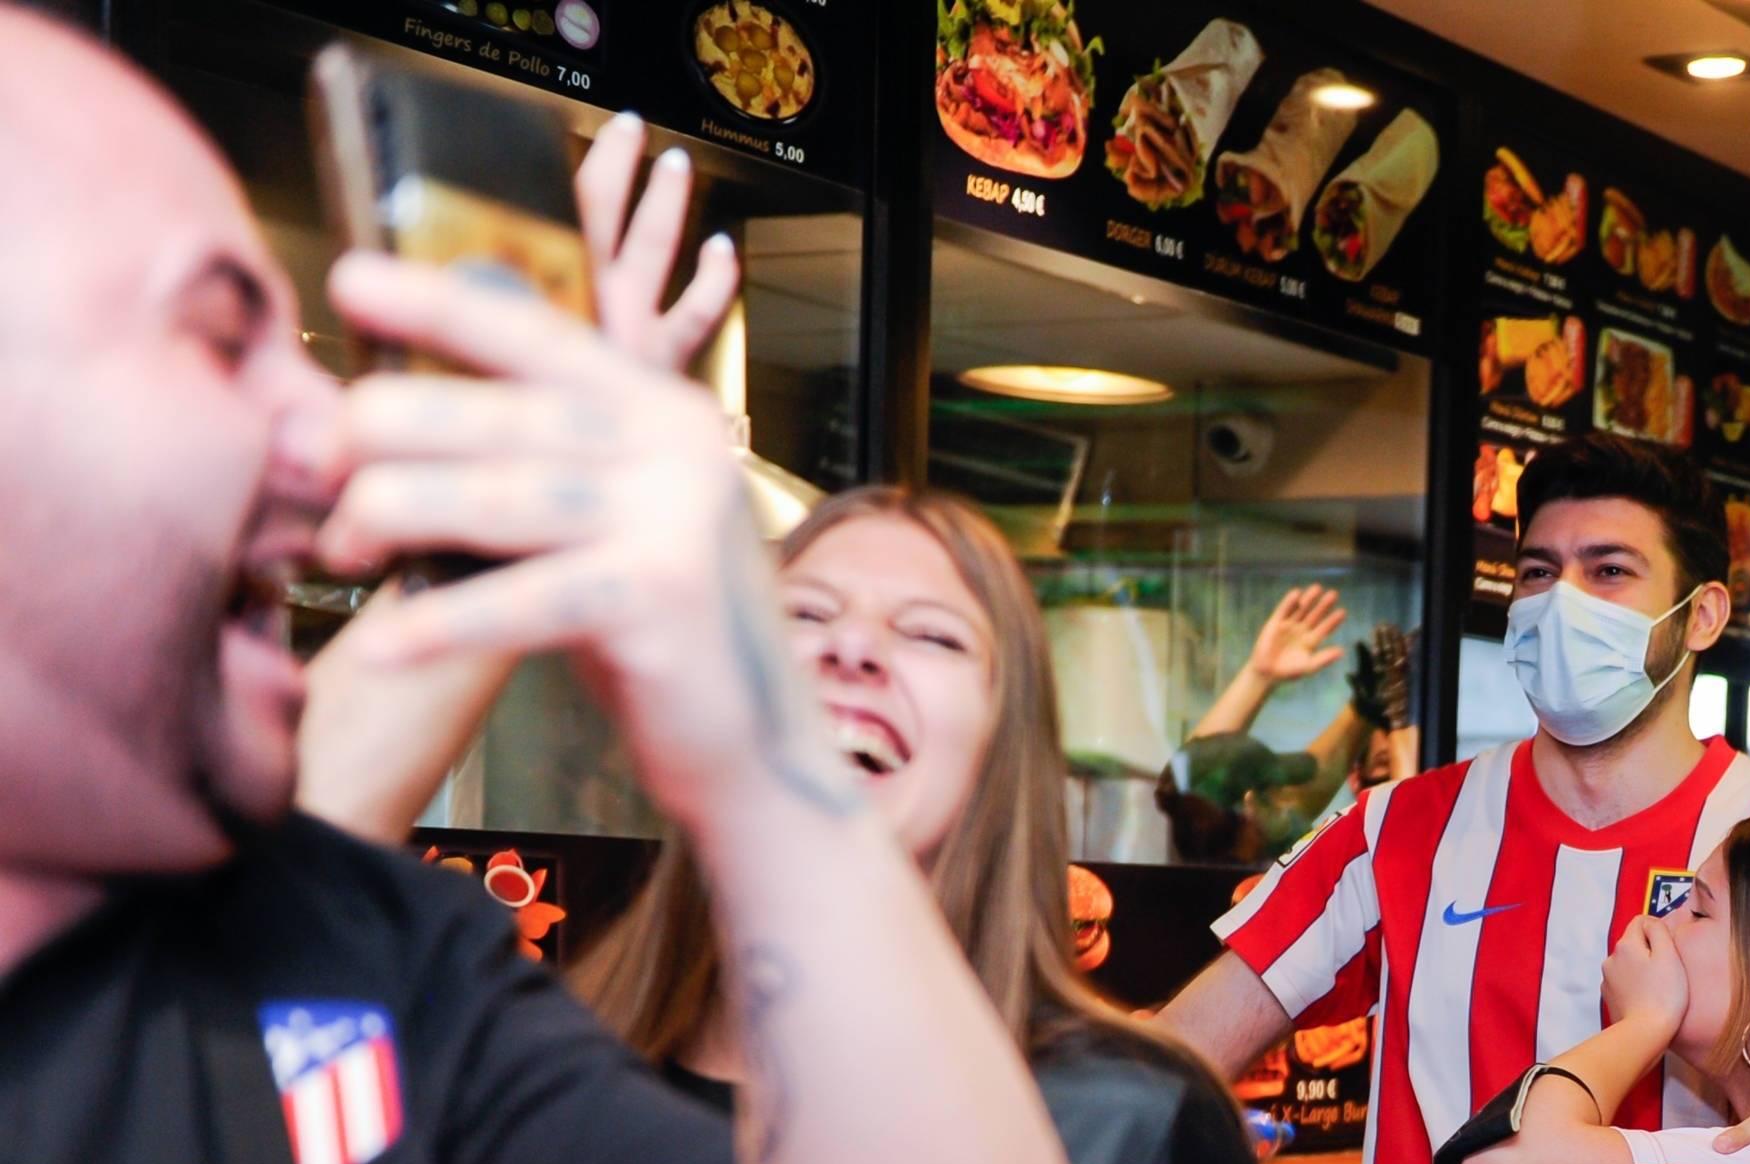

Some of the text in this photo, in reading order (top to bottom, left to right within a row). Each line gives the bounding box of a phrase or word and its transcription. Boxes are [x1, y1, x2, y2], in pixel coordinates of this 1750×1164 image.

[404, 17, 591, 91] Fingers de Pollo 7,00
[701, 117, 805, 164] Hummus 5,00
[966, 174, 1010, 204] KEBAP
[1296, 1078, 1338, 1102] 9,90 €
[1282, 1104, 1339, 1131] X-Large
[1343, 1100, 1368, 1124] Bur
